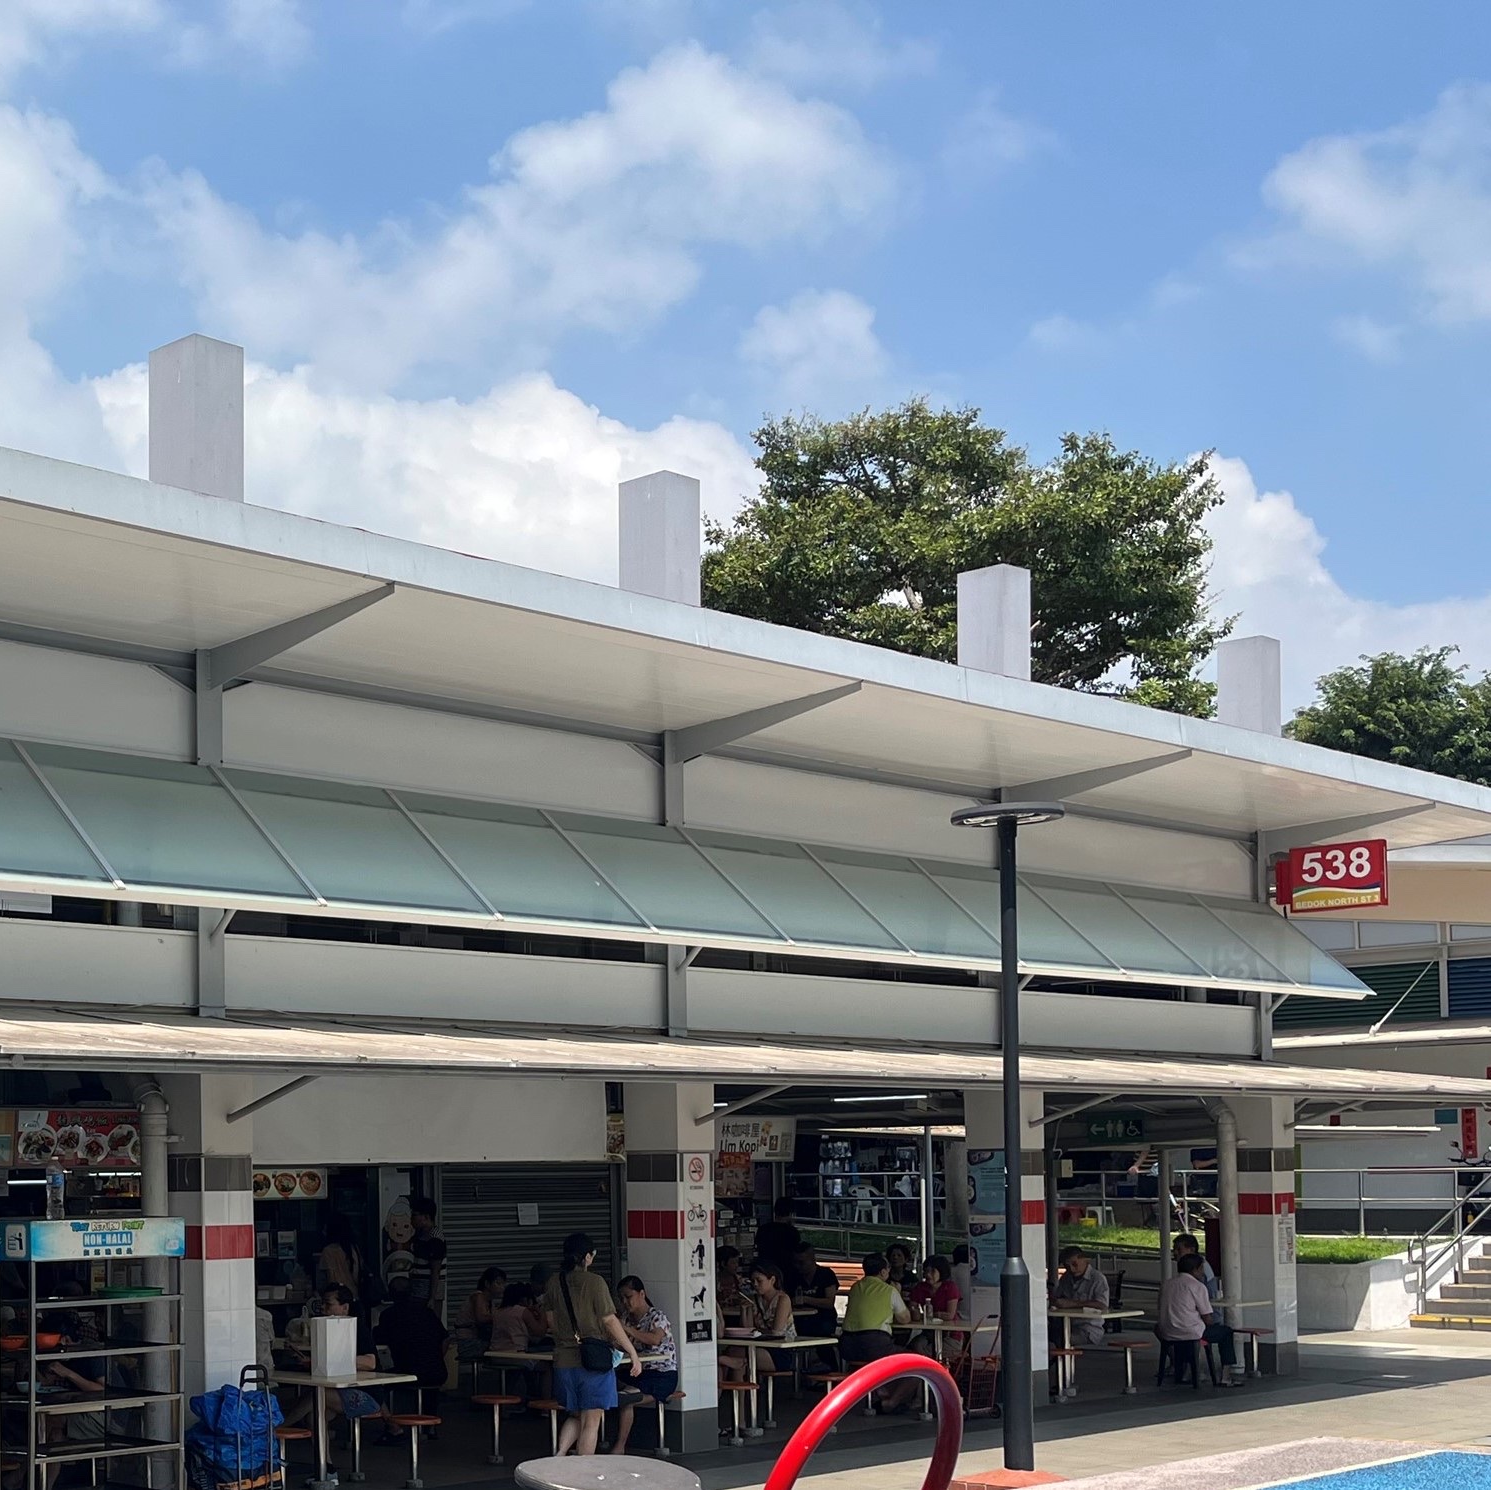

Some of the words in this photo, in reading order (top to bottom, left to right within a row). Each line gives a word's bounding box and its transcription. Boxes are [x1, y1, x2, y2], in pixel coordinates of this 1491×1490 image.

[1302, 847, 1371, 883] 538
[1295, 899, 1326, 909] BEDOK
[1328, 896, 1358, 906] NORTH
[1360, 895, 1372, 903] ST
[1373, 895, 1379, 903] 3
[720, 1138, 736, 1152] Lim
[739, 1139, 759, 1154] Kopi
[70, 1222, 90, 1232] TRAY
[91, 1221, 120, 1232] RETURN
[121, 1220, 145, 1230] POINT
[84, 1232, 132, 1246] NON-HALAL
